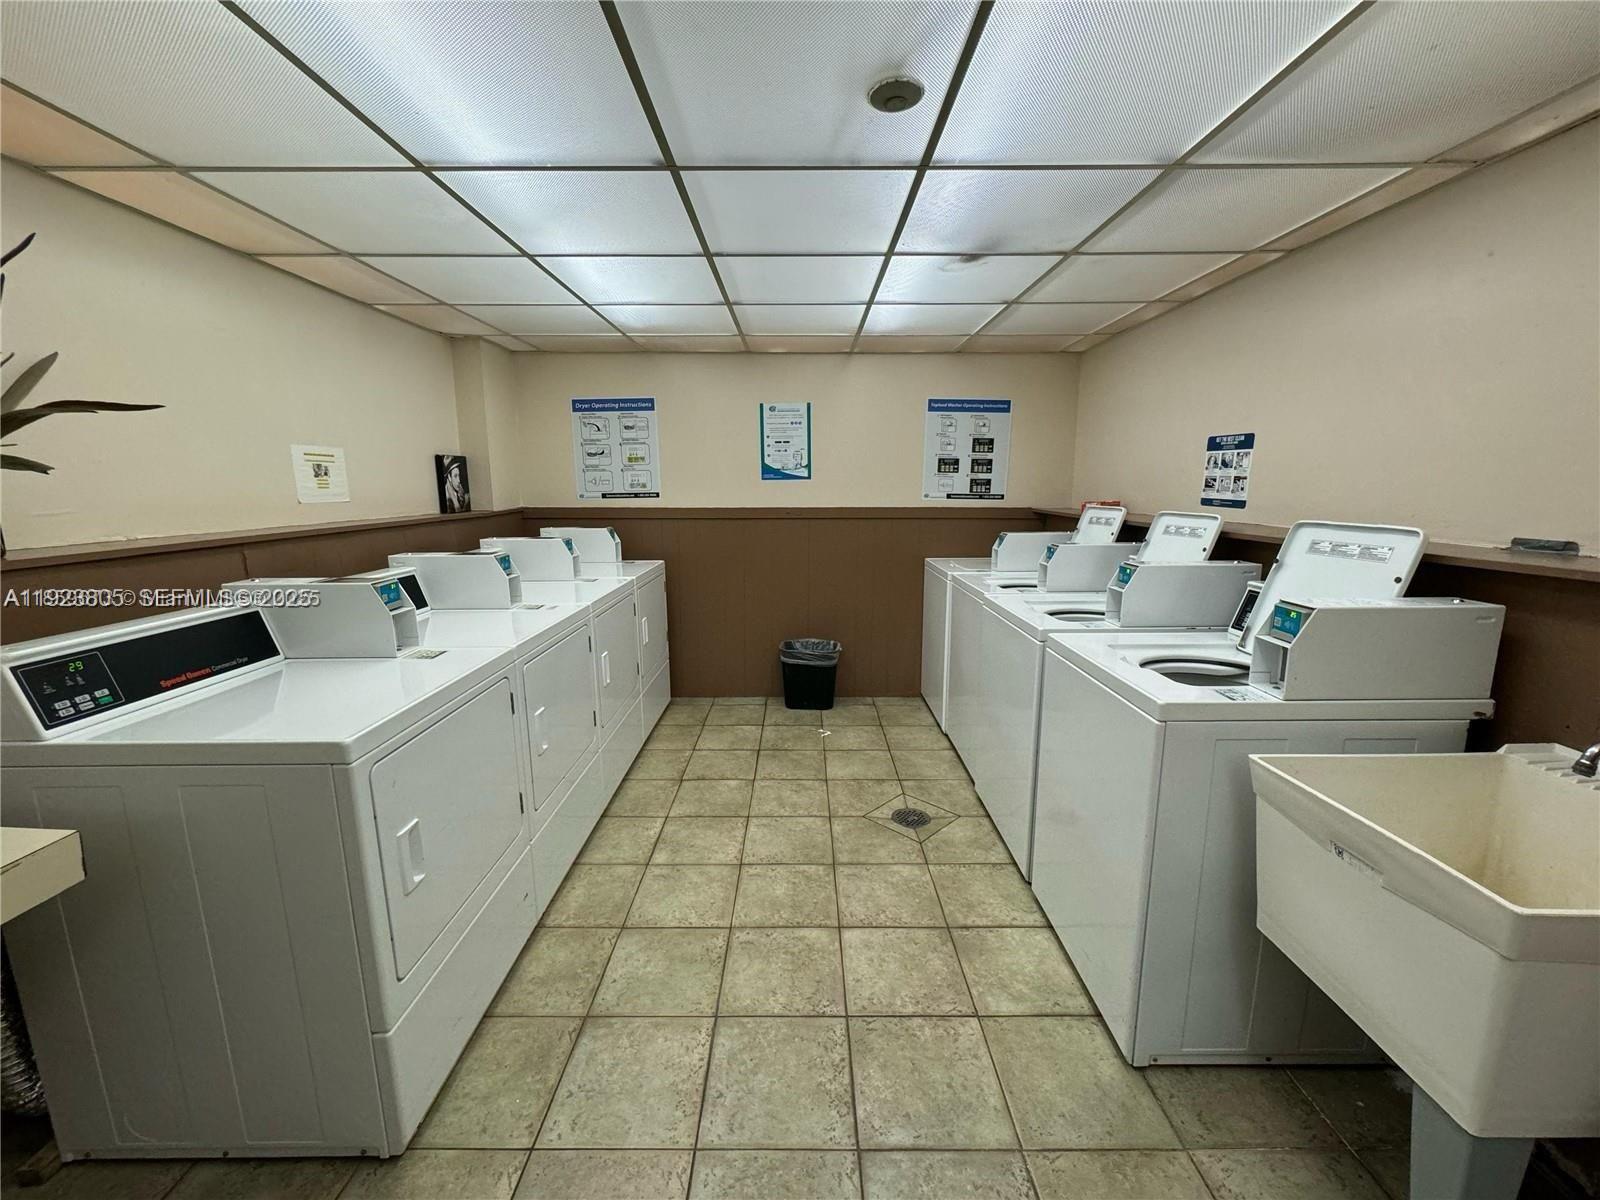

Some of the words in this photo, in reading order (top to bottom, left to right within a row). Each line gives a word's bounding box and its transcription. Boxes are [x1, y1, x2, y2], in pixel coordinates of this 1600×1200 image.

[575, 402, 590, 410] Dryer
[69, 661, 84, 672] 29
[160, 673, 186, 688] Speed
